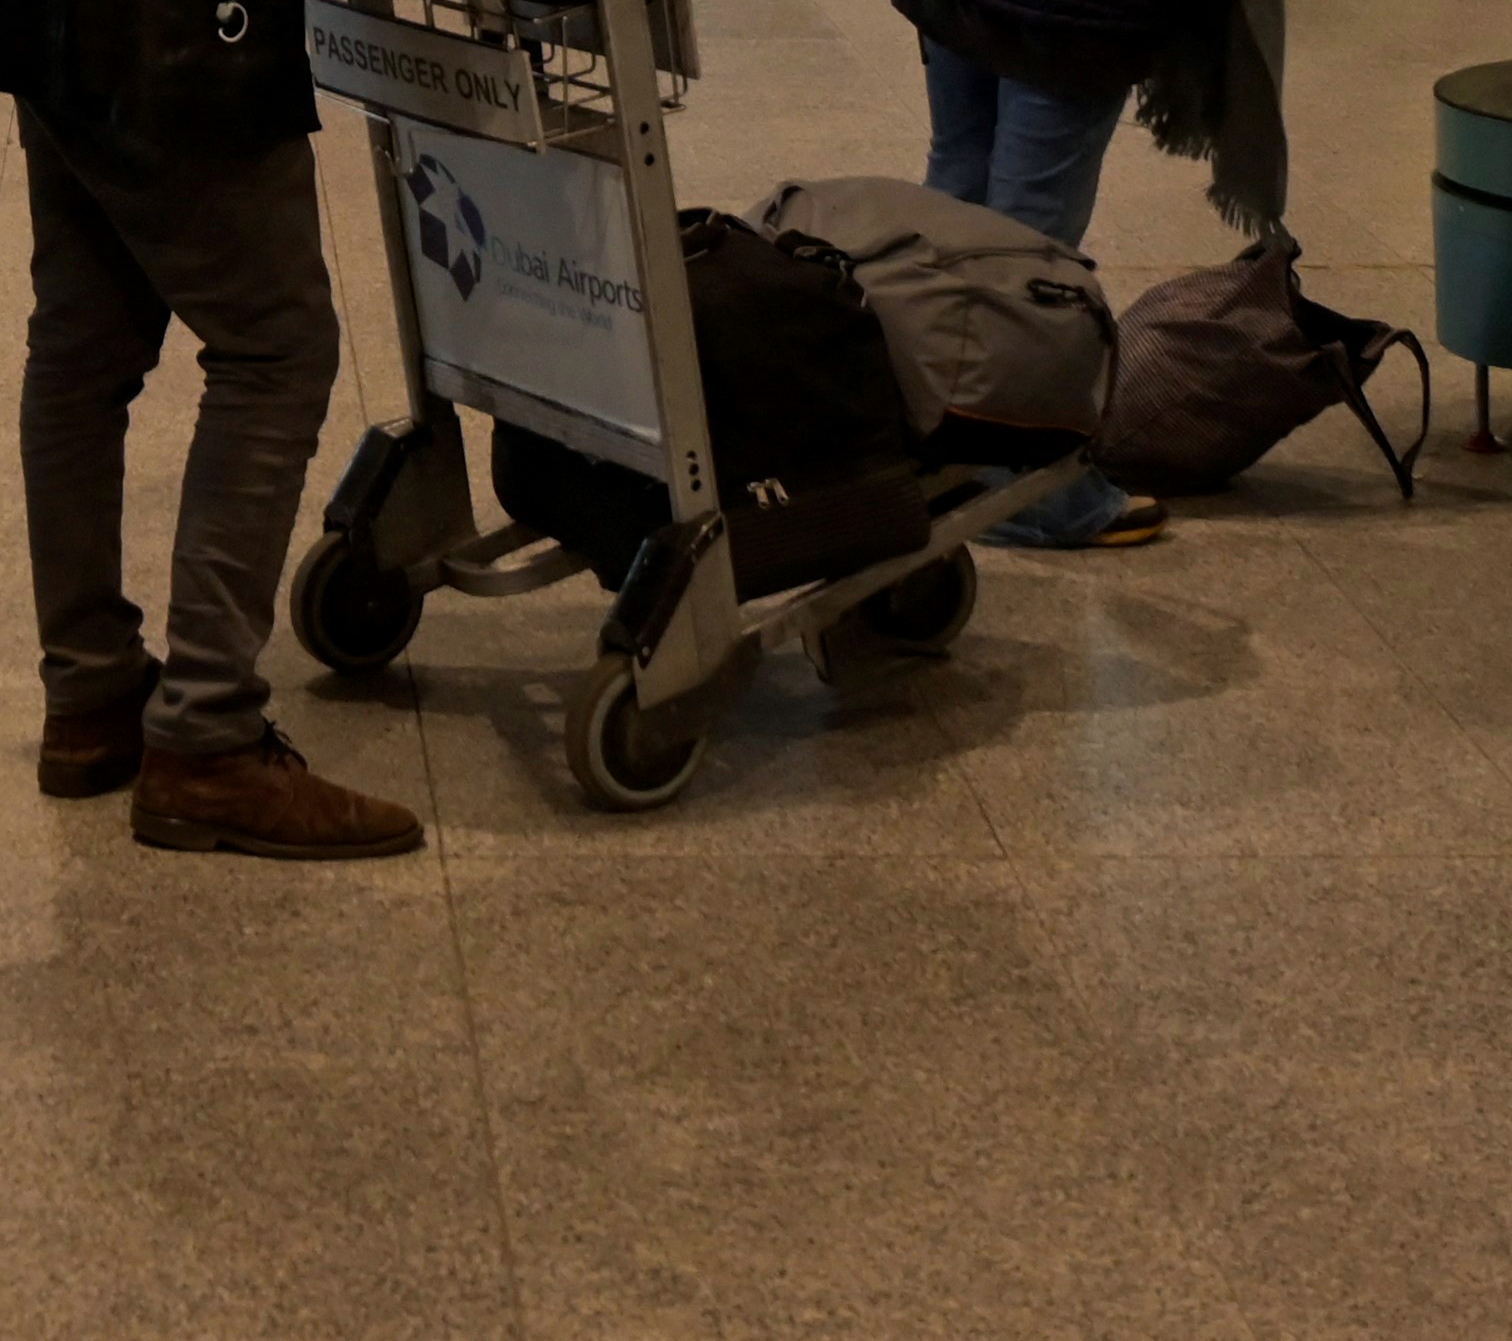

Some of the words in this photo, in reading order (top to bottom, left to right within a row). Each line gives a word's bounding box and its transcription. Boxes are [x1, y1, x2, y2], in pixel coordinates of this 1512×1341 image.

[313, 27, 449, 93] PASSENGER
[455, 67, 522, 112] ONLY
[558, 258, 643, 314] Airports
